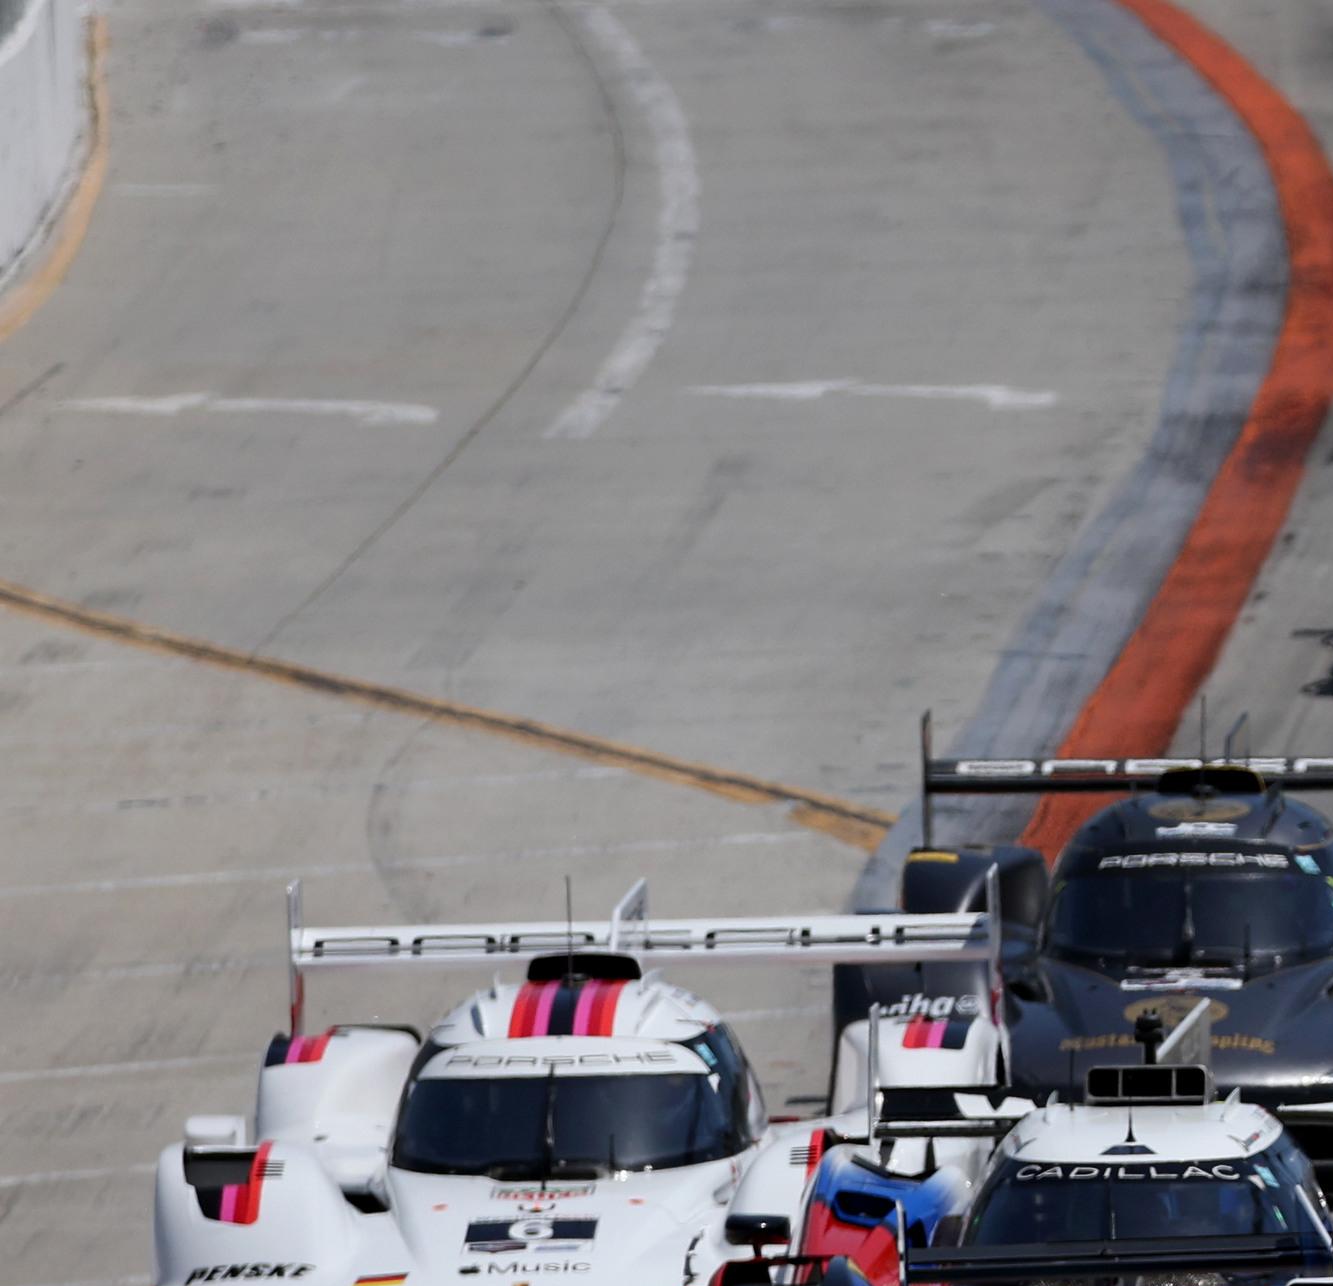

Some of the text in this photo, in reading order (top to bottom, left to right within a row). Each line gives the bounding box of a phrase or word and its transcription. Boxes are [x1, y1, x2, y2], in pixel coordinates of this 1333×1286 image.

[1099, 853, 1289, 870] PORSCHE
[445, 1051, 676, 1068] PORSCHE
[1016, 1165, 1239, 1181] CADILLAC
[508, 1219, 553, 1241] 6
[184, 1262, 316, 1286] PENSKE
[487, 1259, 591, 1275] Music
